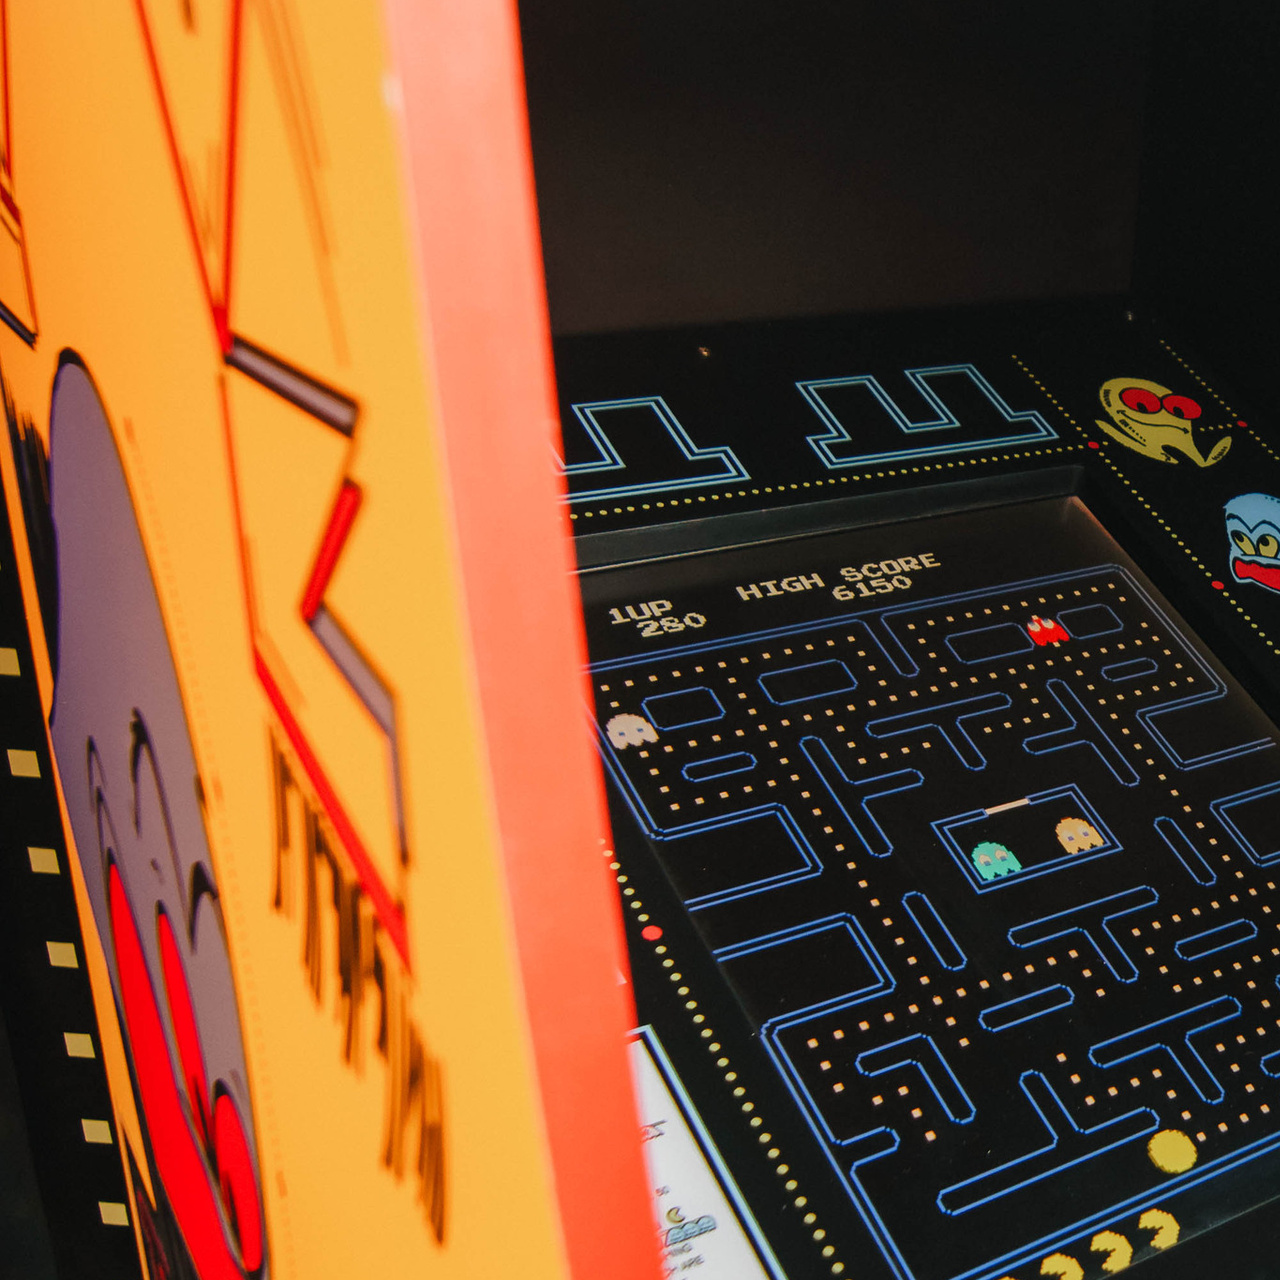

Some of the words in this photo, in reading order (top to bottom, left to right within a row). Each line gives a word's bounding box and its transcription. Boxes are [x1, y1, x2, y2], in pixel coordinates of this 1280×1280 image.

[736, 572, 826, 601] HIGH
[839, 552, 942, 582] SCORE
[832, 575, 913, 601] 6150
[609, 600, 673, 625] 1UP
[636, 612, 707, 637] 280
